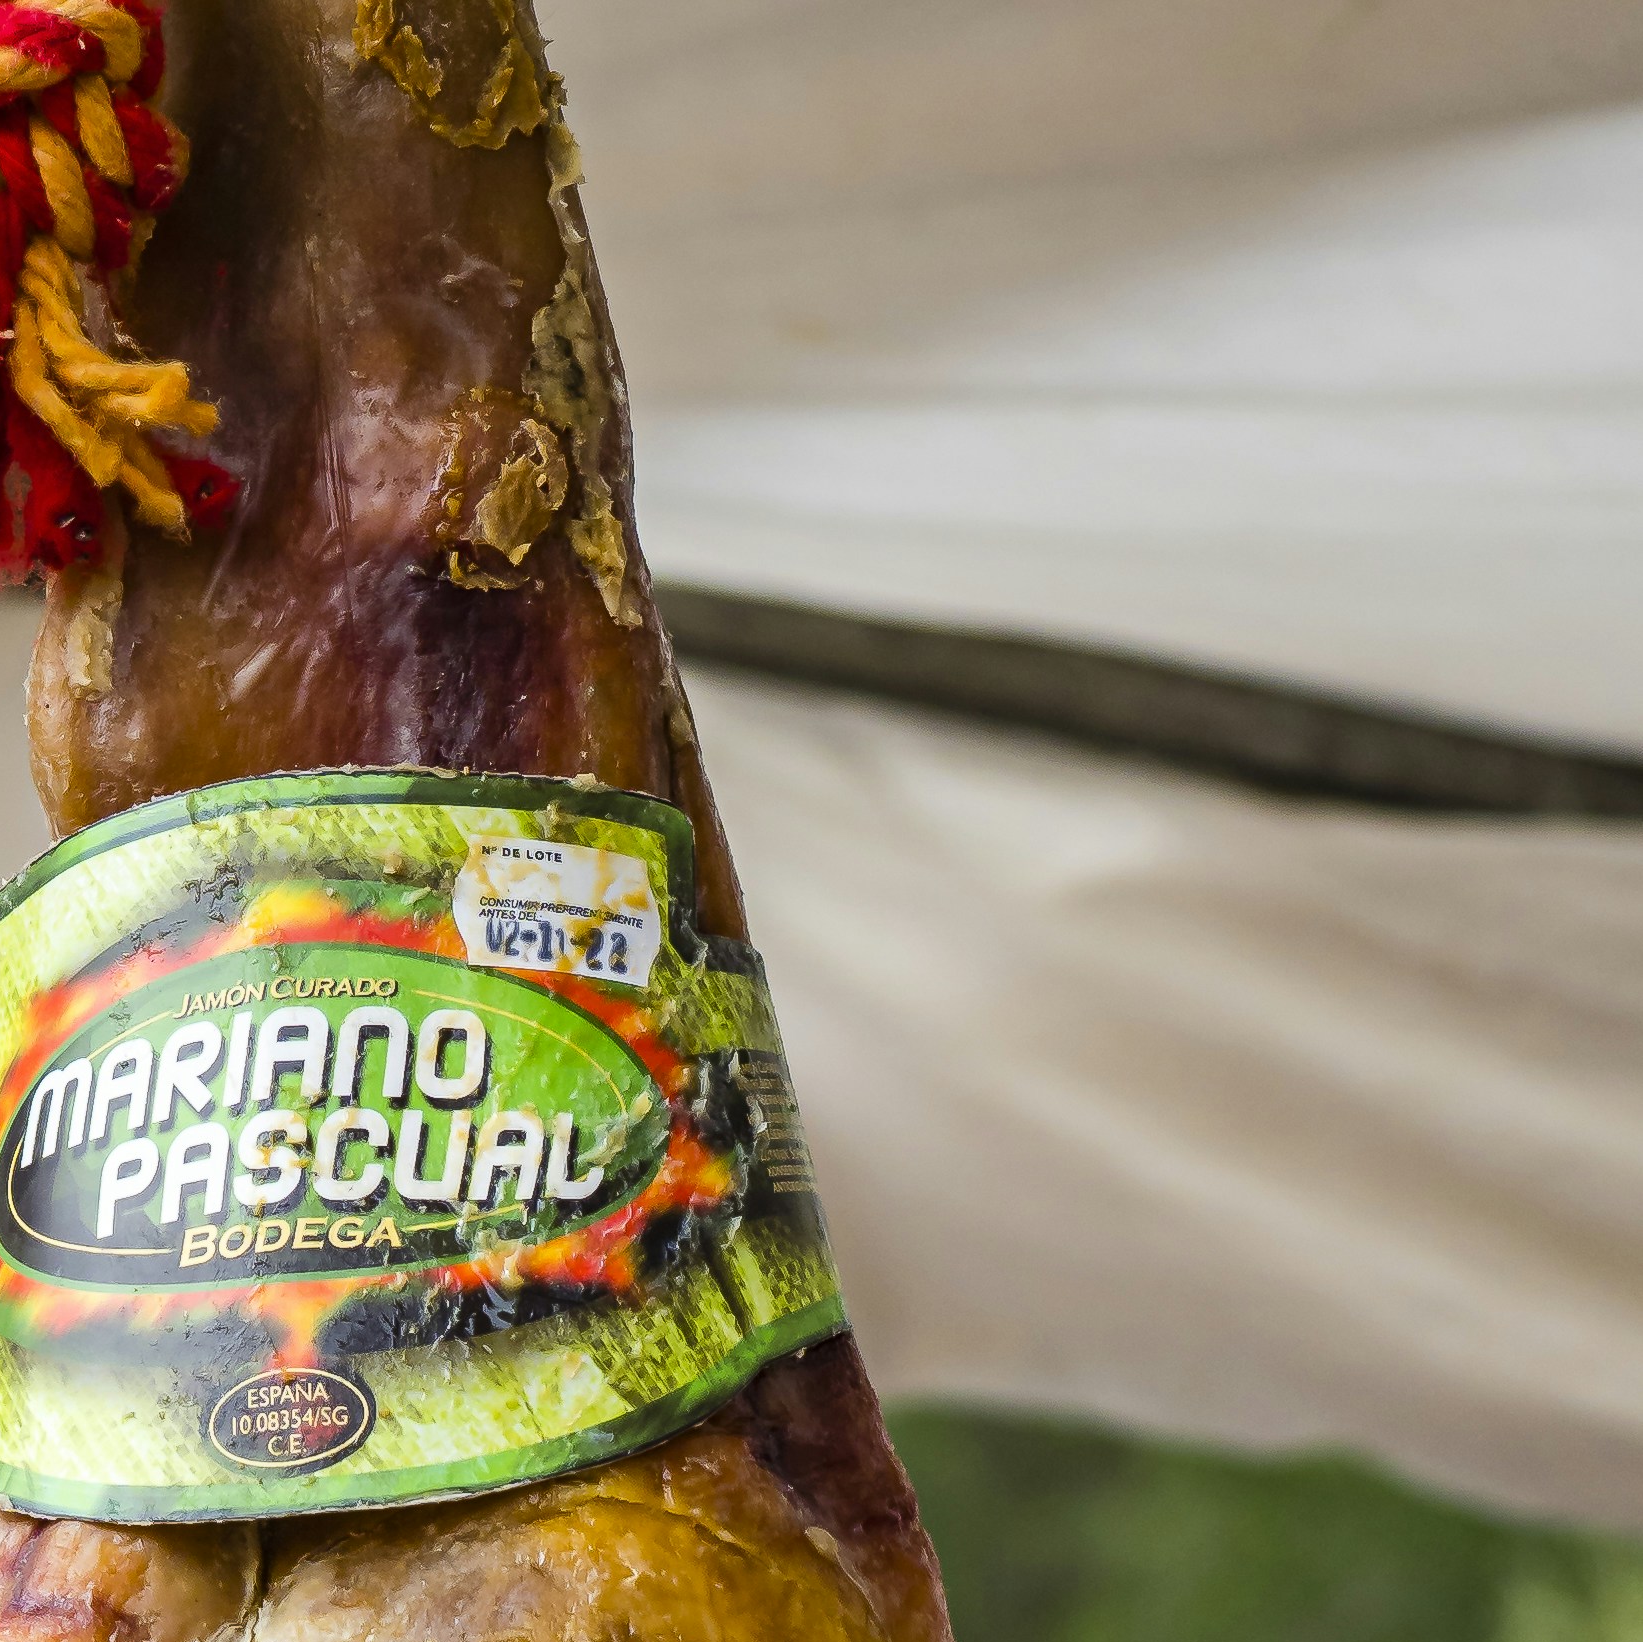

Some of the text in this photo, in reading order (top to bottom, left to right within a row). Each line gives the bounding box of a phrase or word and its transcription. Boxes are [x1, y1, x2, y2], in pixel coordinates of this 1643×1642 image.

[502, 847, 521, 858] DE
[526, 850, 563, 863] LOTE
[479, 908, 517, 919] ANTES
[173, 974, 399, 1020] JAMÓN CURADO
[20, 1006, 485, 1170] MARIANO
[96, 1109, 605, 1240] PASCUAL
[178, 1216, 404, 1270] BODEGA
[247, 1378, 330, 1409] ESPAÑA
